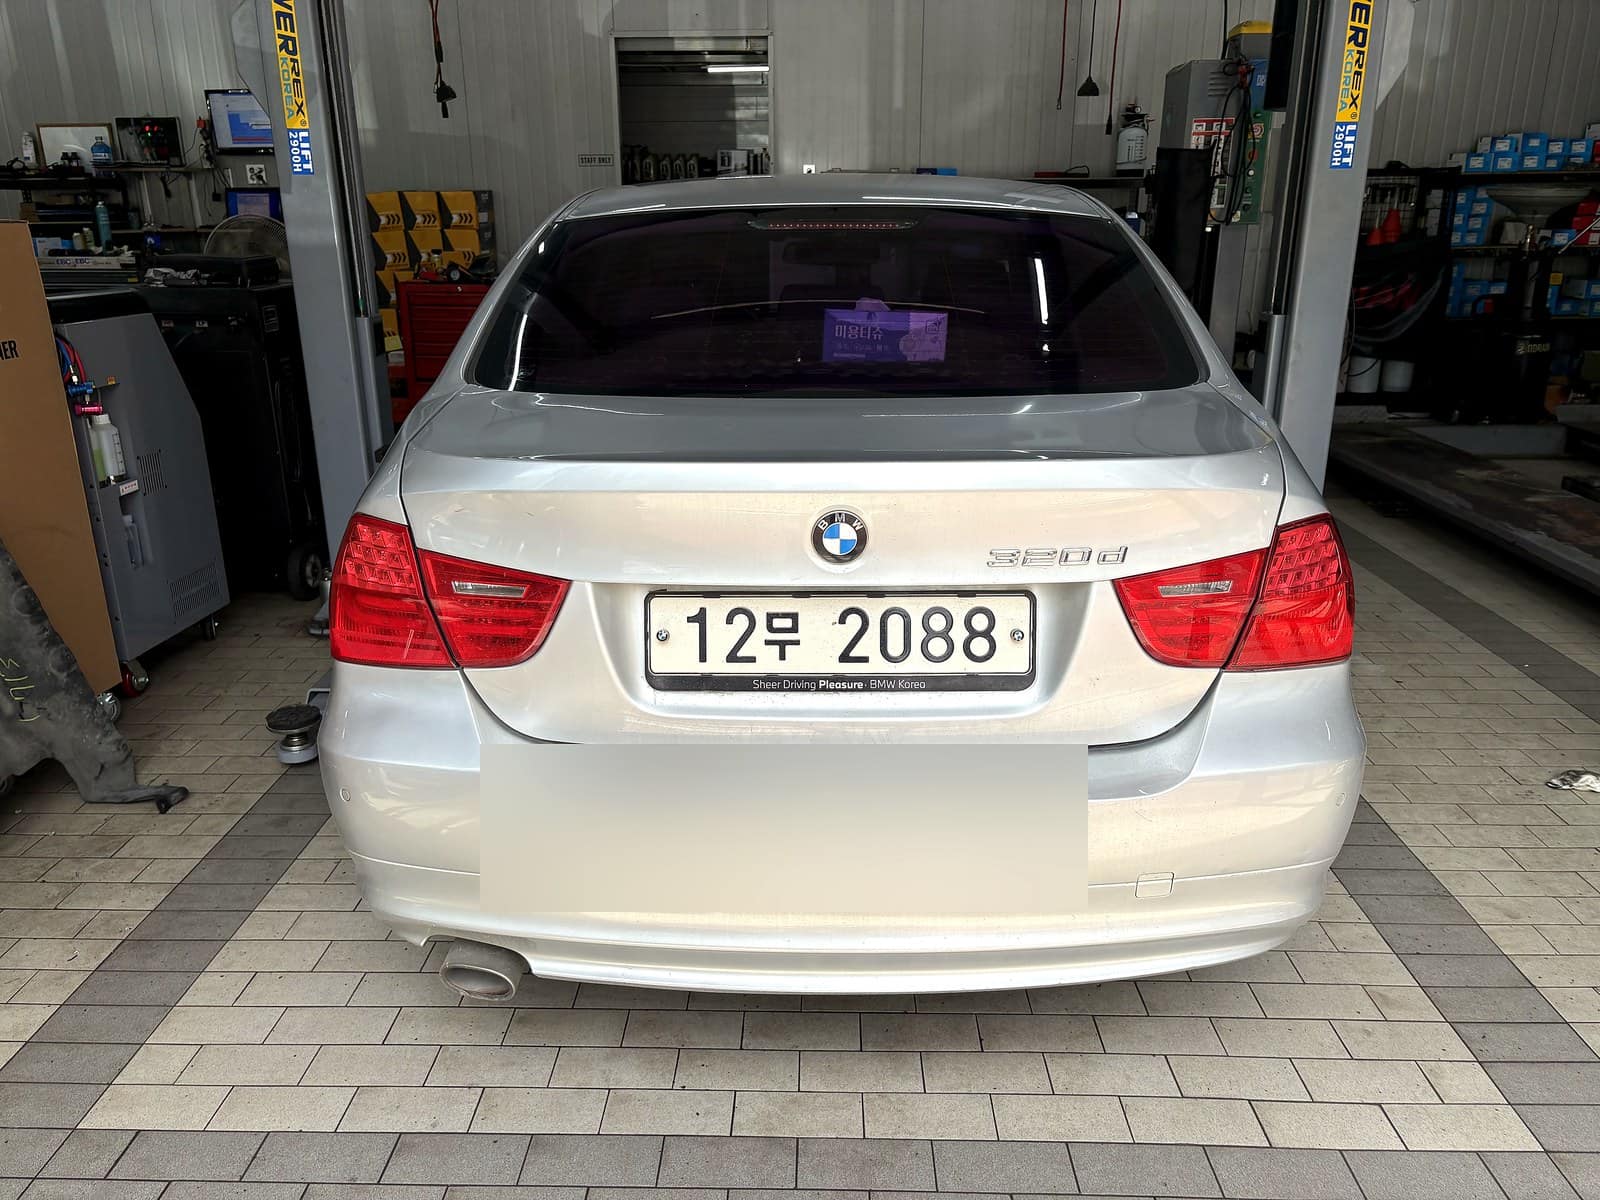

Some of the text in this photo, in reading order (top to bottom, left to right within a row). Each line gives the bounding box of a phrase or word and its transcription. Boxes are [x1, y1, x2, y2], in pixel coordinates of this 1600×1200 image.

[1348, 0, 1371, 110] ERREX
[280, 57, 295, 119] KOREA
[1339, 49, 1355, 112] KOREA
[289, 131, 302, 172] 2900H
[299, 131, 313, 173] LIFT
[1332, 125, 1346, 167] 2900H
[1342, 124, 1357, 167] LIFT
[818, 513, 863, 531] BMW
[986, 546, 1128, 567] 320d
[837, 606, 997, 664] 2088
[752, 679, 926, 691] Sheer Driving Pleasure BMW Korea
